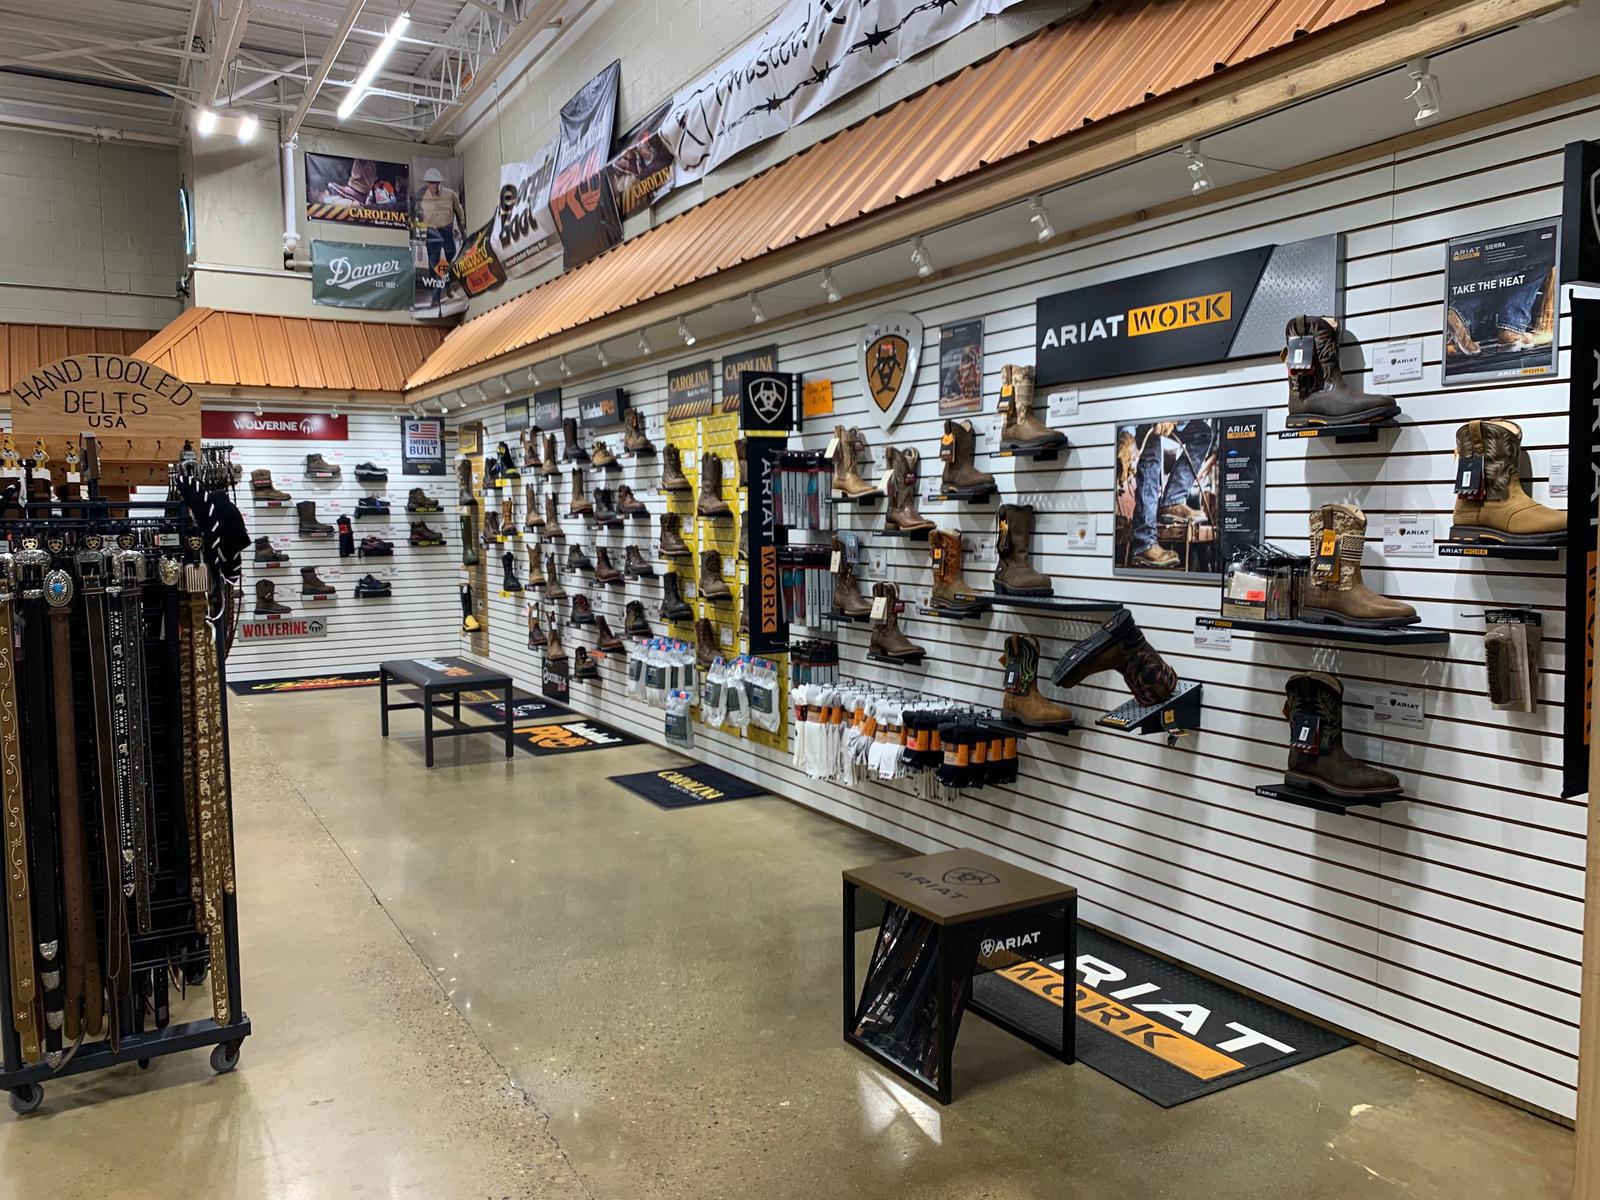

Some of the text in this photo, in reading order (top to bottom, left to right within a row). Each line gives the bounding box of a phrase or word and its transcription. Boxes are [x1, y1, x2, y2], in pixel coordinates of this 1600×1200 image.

[349, 207, 407, 222] CAROLINA
[1453, 246, 1480, 256] ARIAT
[1484, 242, 1506, 251] SIERRA
[325, 256, 400, 286] Danner
[1452, 275, 1525, 295] TAKE THE HEAT
[1041, 294, 1225, 350] ARIAT WORK
[13, 355, 194, 407] HAND TOOLED
[670, 369, 710, 393] CAROLINA
[64, 390, 149, 416] BELTS
[88, 415, 128, 429] USA
[233, 419, 298, 432] WOLVERINE
[1227, 424, 1257, 433] ARIAT
[409, 446, 438, 455] BUILT
[761, 457, 775, 542] ARIAT
[762, 550, 776, 629] WORK
[242, 620, 308, 638] WOLVERINE
[894, 871, 969, 900] ARIAT
[994, 931, 1041, 953] ARIAT
[1007, 965, 1180, 1050] WORK
[1049, 953, 1297, 1055] RIAT
